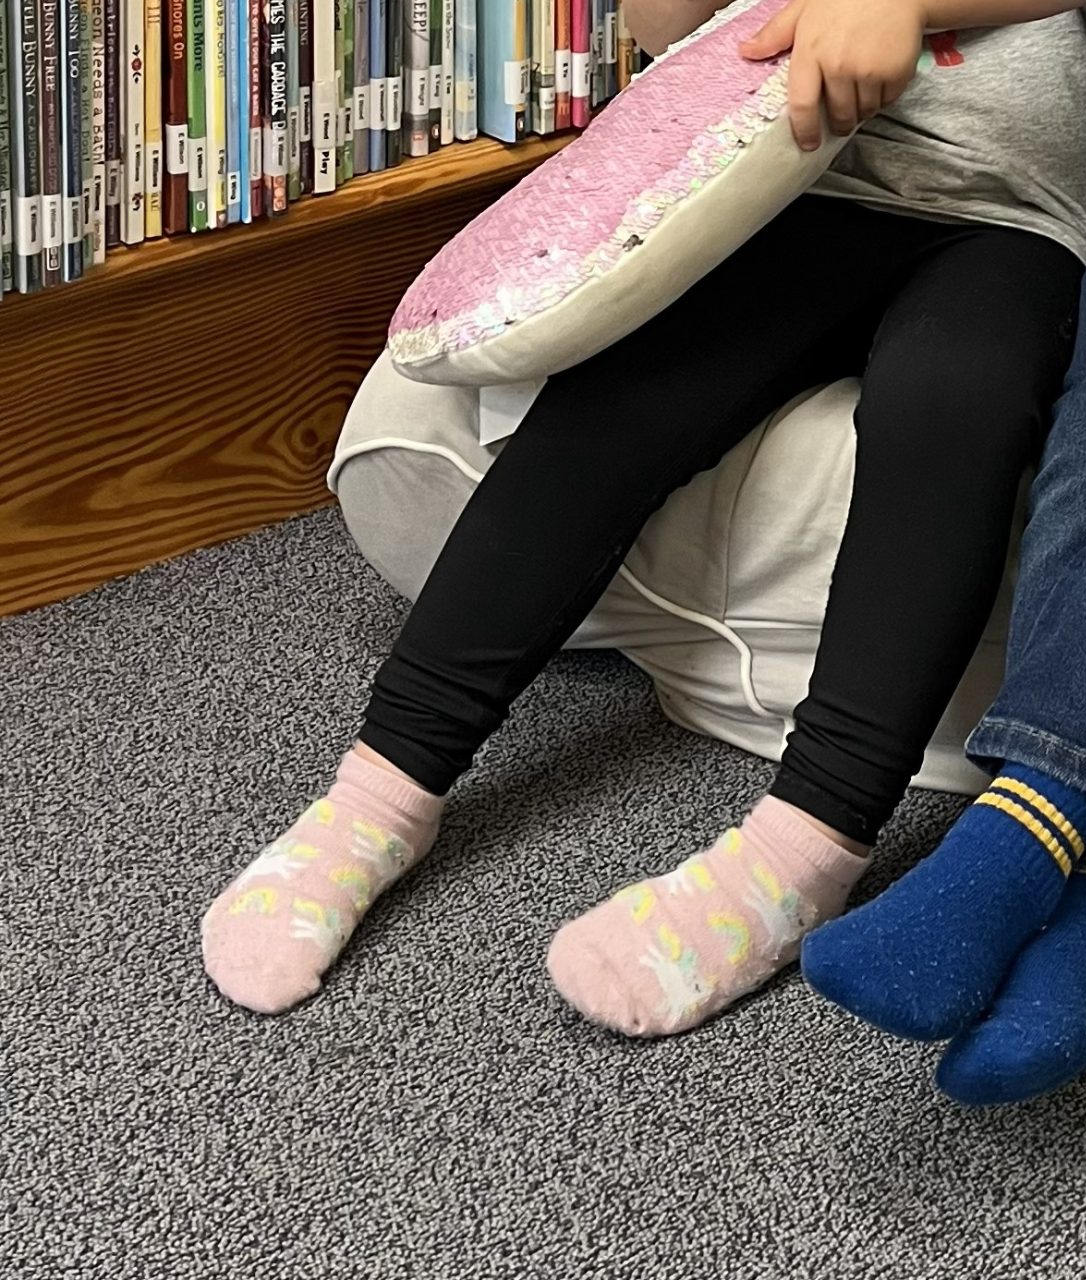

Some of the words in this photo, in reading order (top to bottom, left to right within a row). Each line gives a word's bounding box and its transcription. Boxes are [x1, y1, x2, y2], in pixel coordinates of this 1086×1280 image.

[43, 3, 56, 49] BUNNY
[147, 7, 160, 27] LIL
[173, 43, 185, 60] On
[193, 32, 205, 71] More
[271, 33, 285, 54] THE
[23, 41, 39, 99] BUNNY
[45, 56, 56, 92] FREE
[70, 50, 81, 78] TOO
[92, 46, 105, 99] Needs
[271, 62, 286, 116] GARBAGE
[93, 108, 101, 117] a
[320, 152, 330, 174] Play
[229, 183, 238, 200] Wing
